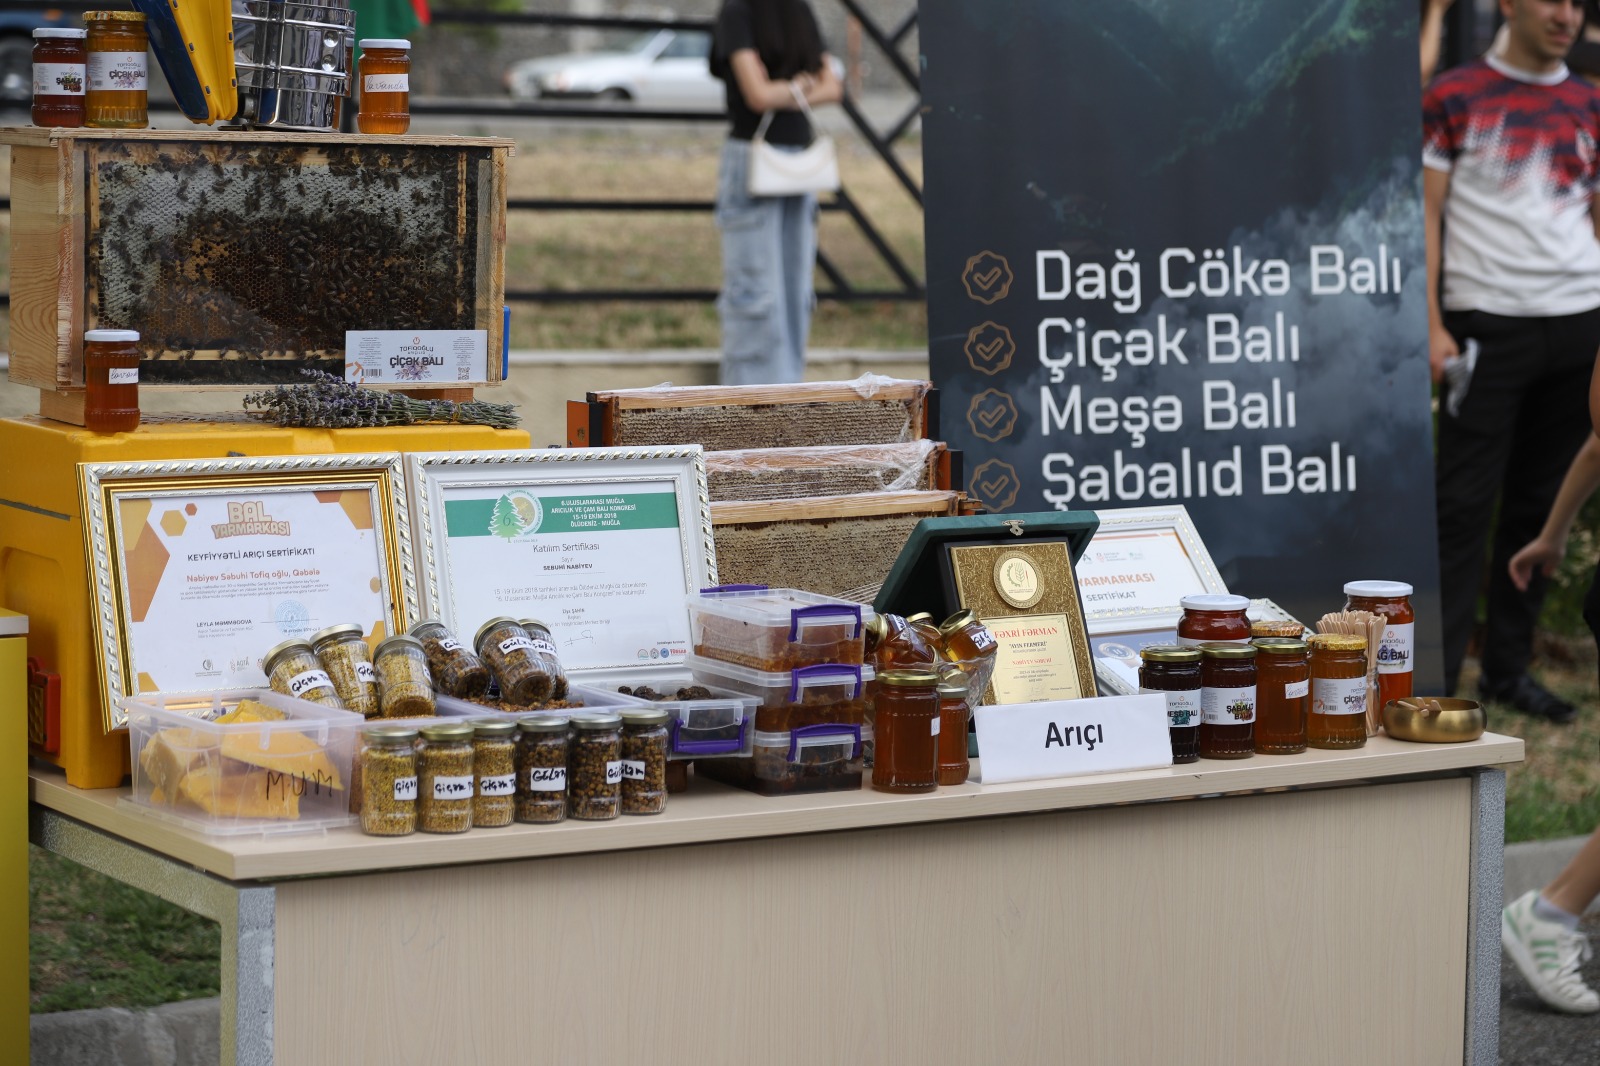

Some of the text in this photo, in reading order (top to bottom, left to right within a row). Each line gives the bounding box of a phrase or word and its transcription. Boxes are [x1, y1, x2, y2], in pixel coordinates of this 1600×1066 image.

[1036, 244, 1402, 314] Dağ Cökə Balı
[1037, 311, 1300, 384] Çiçək Balı
[389, 355, 444, 369] ÇİÇƏK BALI
[1040, 378, 1296, 448] Meşə Balı
[1042, 441, 1357, 511] Şabalıd Balı
[227, 501, 272, 524] BAL
[211, 521, 291, 540] YARMARKASI
[187, 547, 315, 562] KEYFİYYƏTLİ ARIÇI SERTİFİKATI
[533, 542, 600, 553] Katılım Sertifikası
[186, 574, 219, 583] Nəbiyev
[220, 571, 249, 581] Səbuhi
[250, 570, 270, 579] Tofiq
[271, 569, 291, 579] oğlu,
[1086, 590, 1137, 602] SERTİFİKAT
[994, 626, 1058, 639] FƏXRİ FƏRMAN
[1045, 721, 1104, 751] Arıçı
[266, 768, 333, 801] MUM
